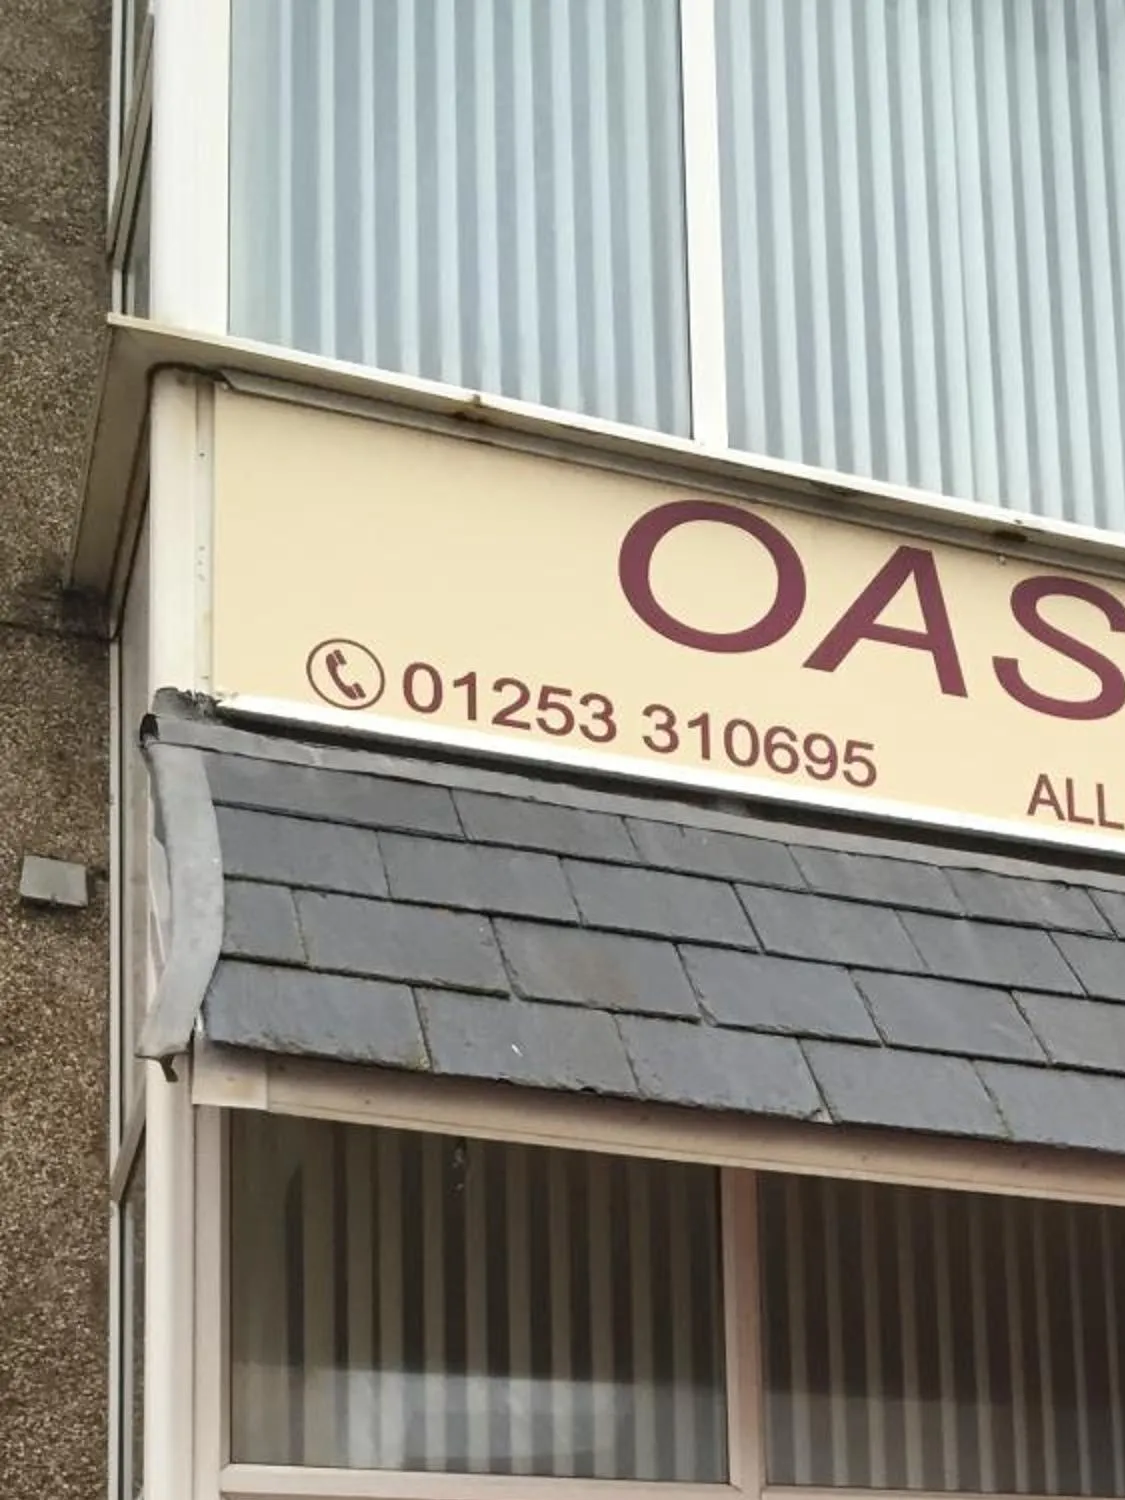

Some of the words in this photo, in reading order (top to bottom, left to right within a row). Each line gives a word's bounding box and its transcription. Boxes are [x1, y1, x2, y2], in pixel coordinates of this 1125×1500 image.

[402, 661, 617, 743] 01253
[642, 703, 878, 788] 310695
[1027, 772, 1125, 831] ALL
